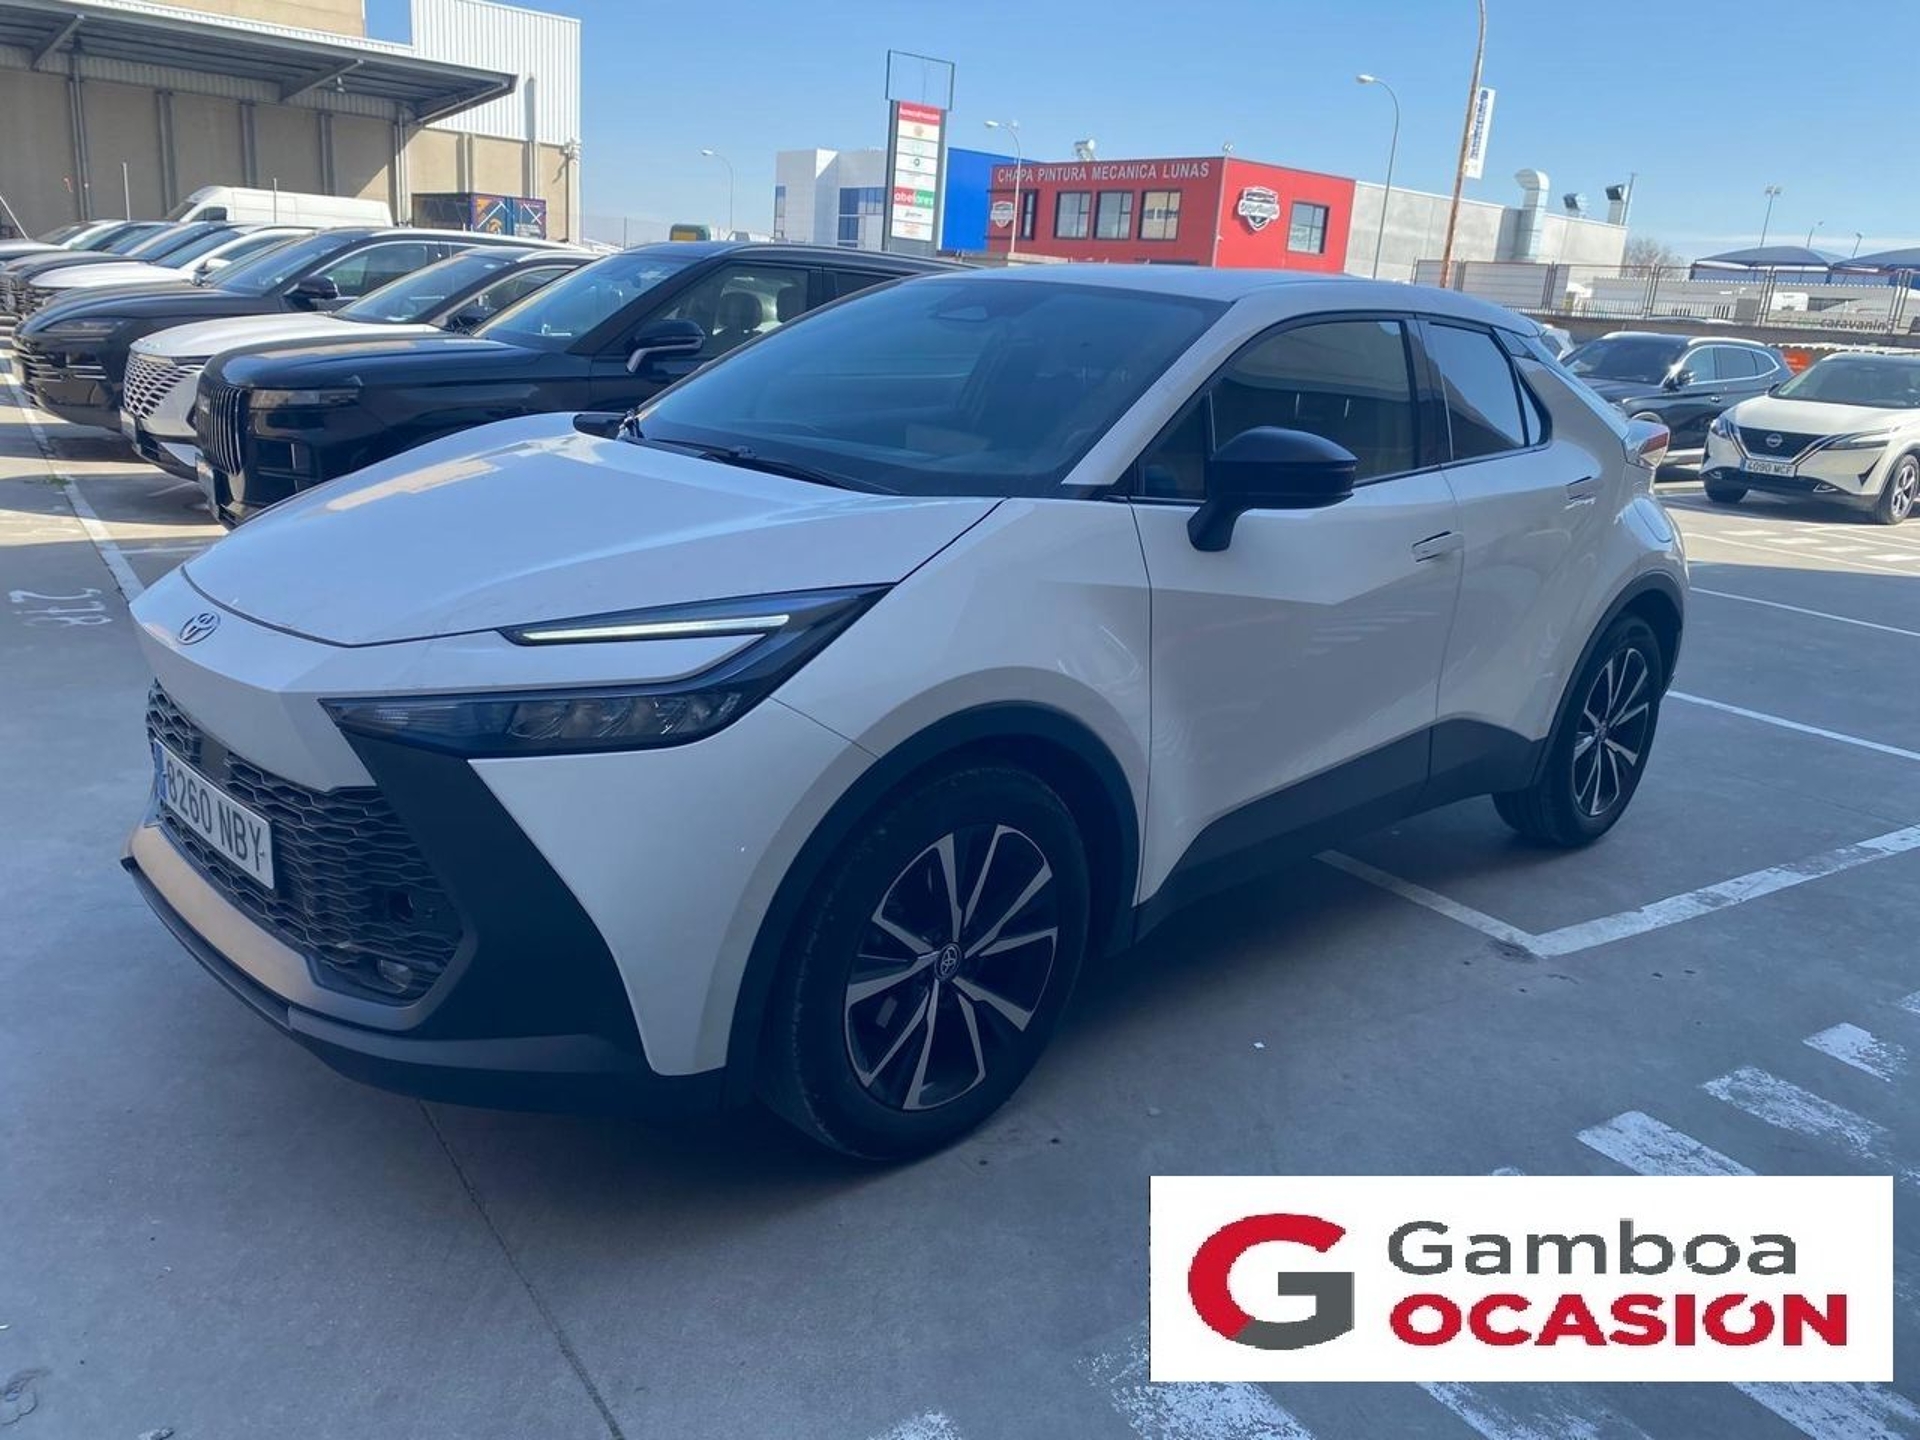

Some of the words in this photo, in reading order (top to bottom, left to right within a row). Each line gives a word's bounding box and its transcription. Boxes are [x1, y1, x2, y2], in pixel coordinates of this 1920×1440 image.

[998, 168, 1033, 183] CHAPA
[1037, 168, 1087, 181] PINTURA
[1091, 165, 1157, 180] MECANICA
[1162, 161, 1210, 178] LUNAS
[166, 760, 212, 834] 8260
[217, 800, 263, 872] NBY
